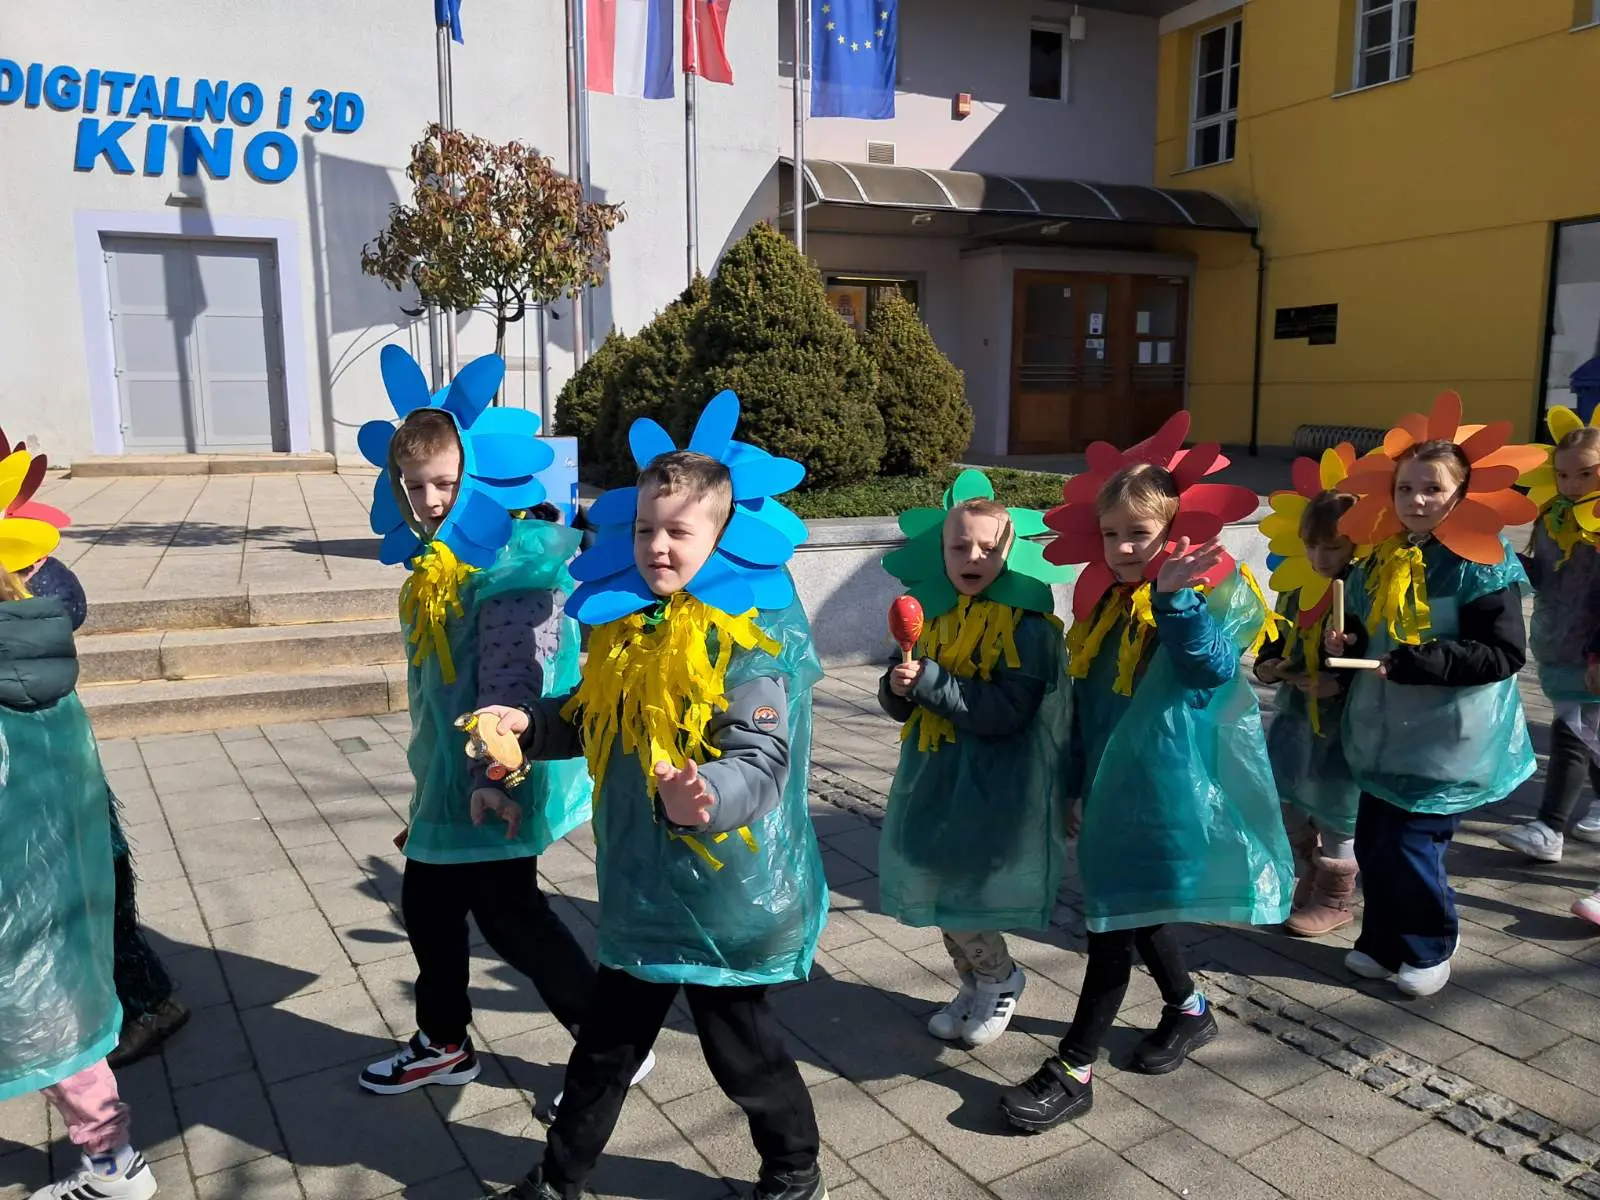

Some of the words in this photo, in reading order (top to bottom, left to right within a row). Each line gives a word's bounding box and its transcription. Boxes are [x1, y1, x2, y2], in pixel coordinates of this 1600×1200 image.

[0, 58, 264, 126] DIGITALNO
[305, 89, 365, 133] 3D
[74, 117, 298, 183] KINO
